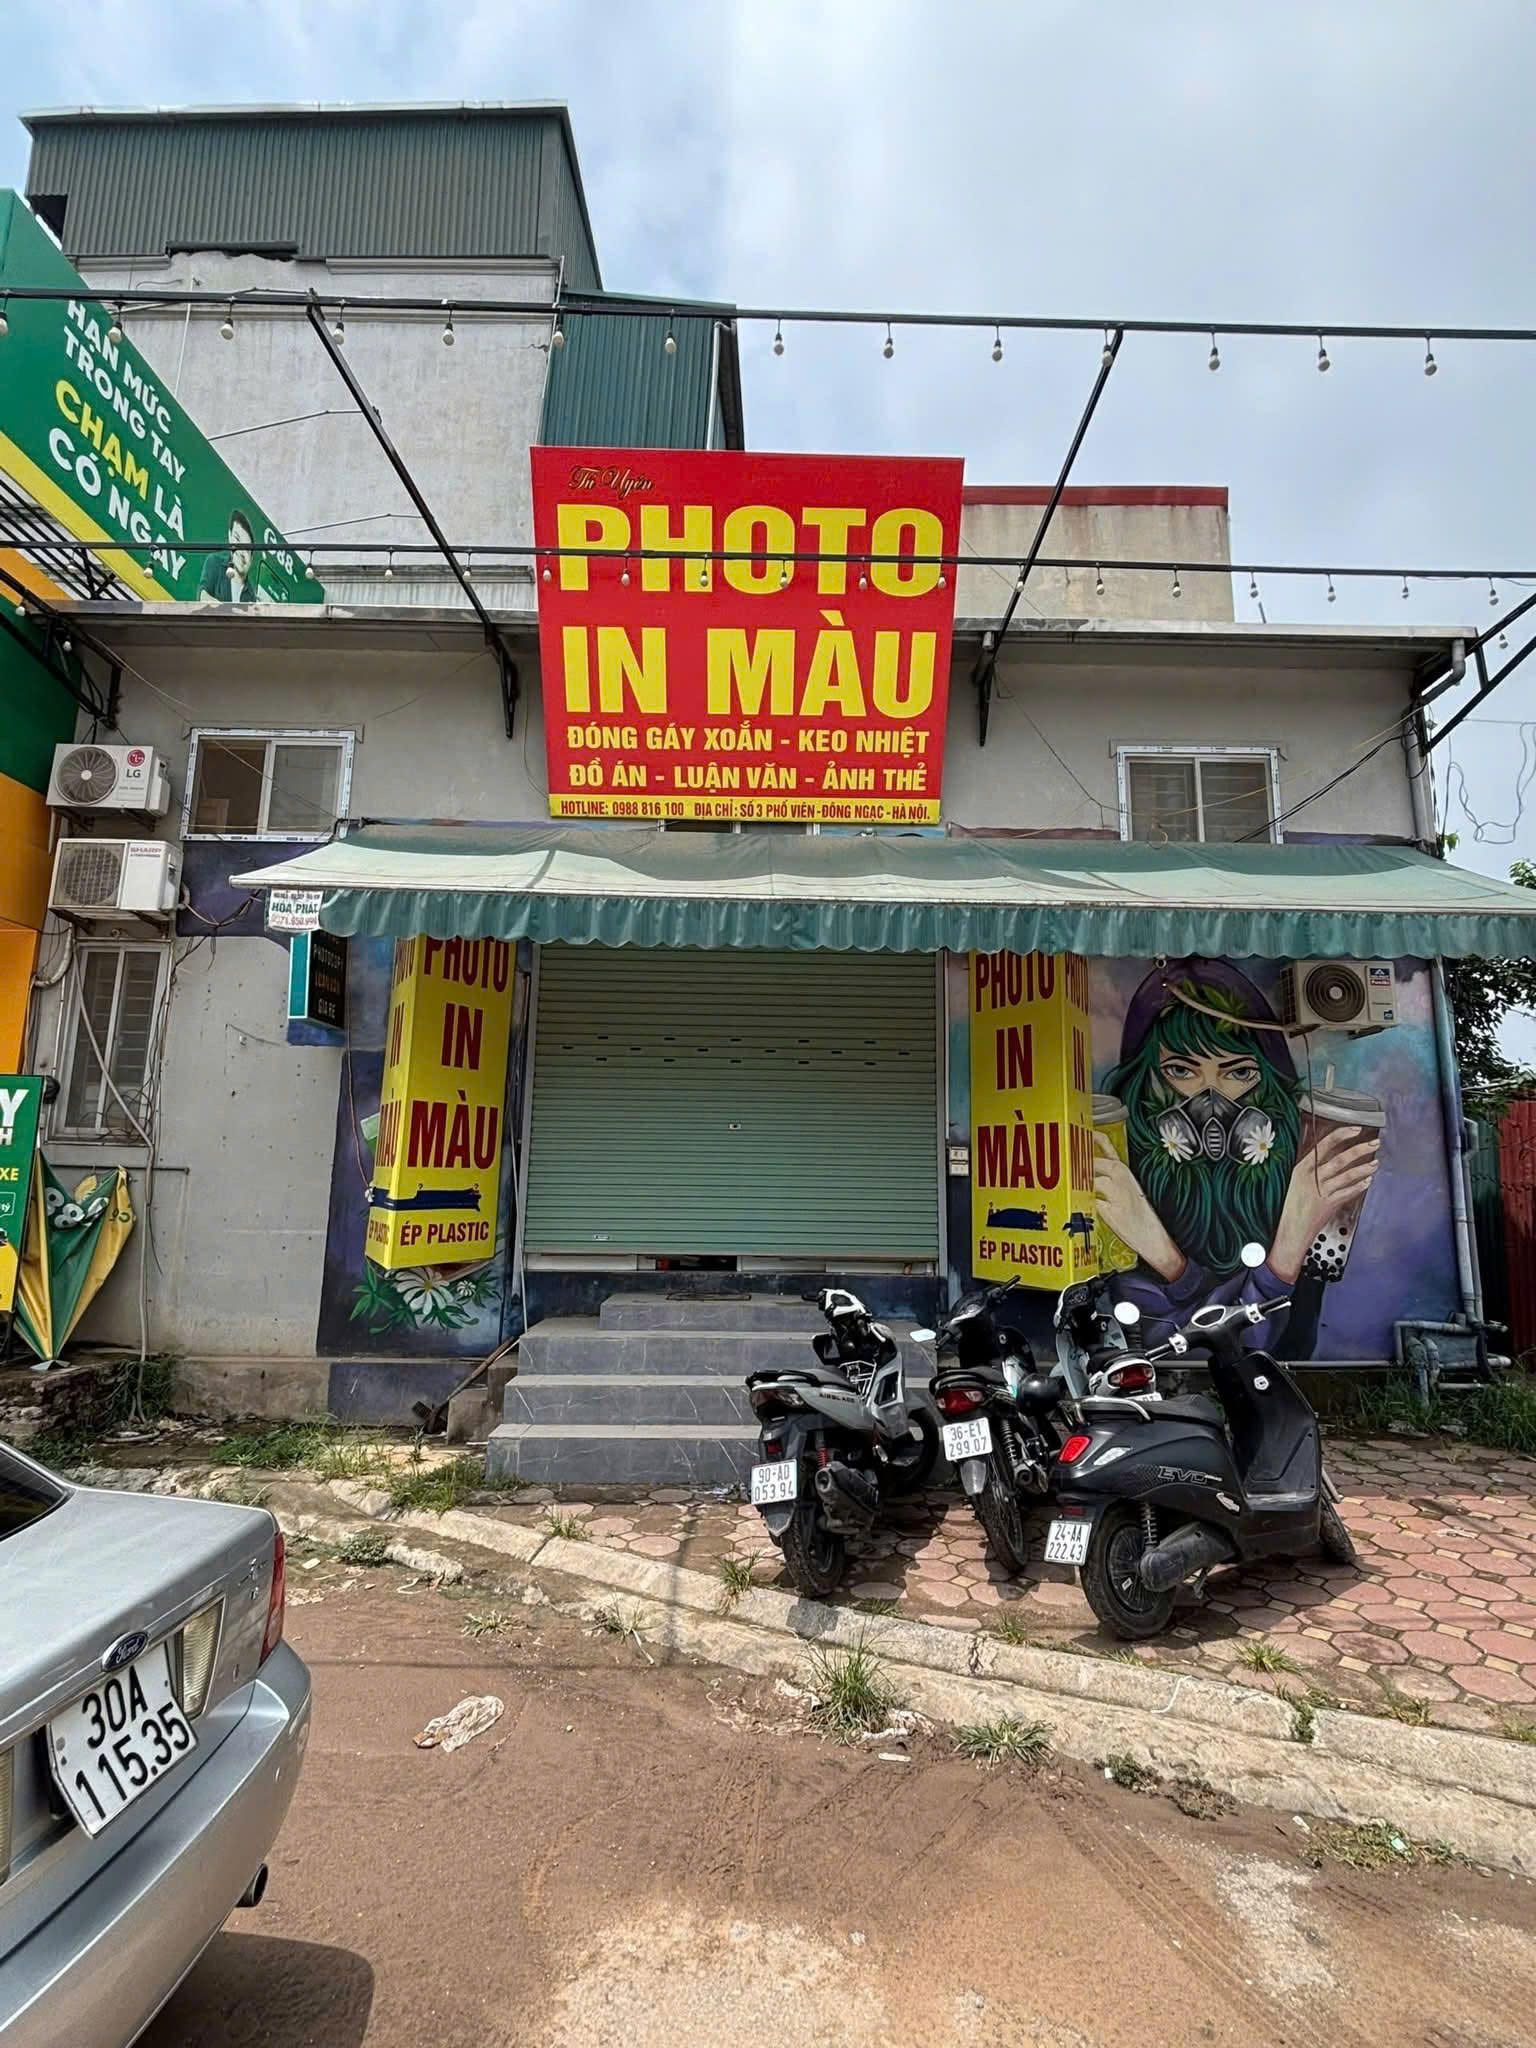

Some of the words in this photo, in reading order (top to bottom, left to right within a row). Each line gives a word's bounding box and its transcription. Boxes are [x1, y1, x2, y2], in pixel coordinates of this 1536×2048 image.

[67, 300, 119, 372] HẠN
[123, 360, 172, 434] MỨC
[63, 325, 146, 440] TRONG
[151, 430, 186, 484] TAY
[55, 379, 149, 501] CHẠM
[154, 484, 185, 542] LÀ
[48, 427, 102, 497] CÓ
[108, 484, 187, 582] NGAY
[556, 503, 943, 598] PHOTO
[561, 625, 668, 715] IN
[706, 609, 938, 720] MÀU
[567, 721, 638, 750] ĐÓNG
[646, 722, 696, 751] GÁY
[703, 719, 773, 752] XOẮN
[798, 729, 848, 753] KEO
[855, 725, 930, 759] NHIỆT
[126, 769, 142, 778] LG
[569, 756, 604, 788] ĐỒ
[611, 759, 648, 788] ÁN
[674, 761, 741, 794] LUẬN
[746, 761, 798, 790] VĂN
[822, 760, 875, 791] ẢNH
[882, 761, 928, 792] THẺ
[561, 800, 609, 816] HOTLINE:
[612, 801, 638, 816] 0988
[641, 802, 661, 816] 816
[664, 802, 685, 817] 100
[694, 802, 713, 818] ĐỊA
[739, 800, 754, 818] SỐ
[756, 804, 763, 818] 3
[766, 800, 788, 818] PHỐ
[855, 805, 884, 822] NGẠC
[892, 801, 906, 820] HÀ
[440, 1002, 485, 1071] IN
[996, 1024, 1033, 1091] IN
[407, 1089, 499, 1170] MÀU
[977, 1109, 1060, 1191] MÀU
[400, 1220, 423, 1247] ÉP
[427, 1221, 489, 1245] PLASTIC
[979, 1235, 997, 1260] ÉP
[1001, 1241, 1064, 1268] PLASTIC
[948, 1436, 987, 1458] 299.07
[950, 1421, 982, 1441] 36-E1
[1157, 1465, 1208, 1485] EVO
[1047, 1541, 1084, 1561] 222.43
[1054, 1524, 1083, 1543] 24-AA
[112, 1637, 140, 1664] Ford
[81, 1665, 148, 1749] 30A
[75, 1701, 190, 1820] 115.35
